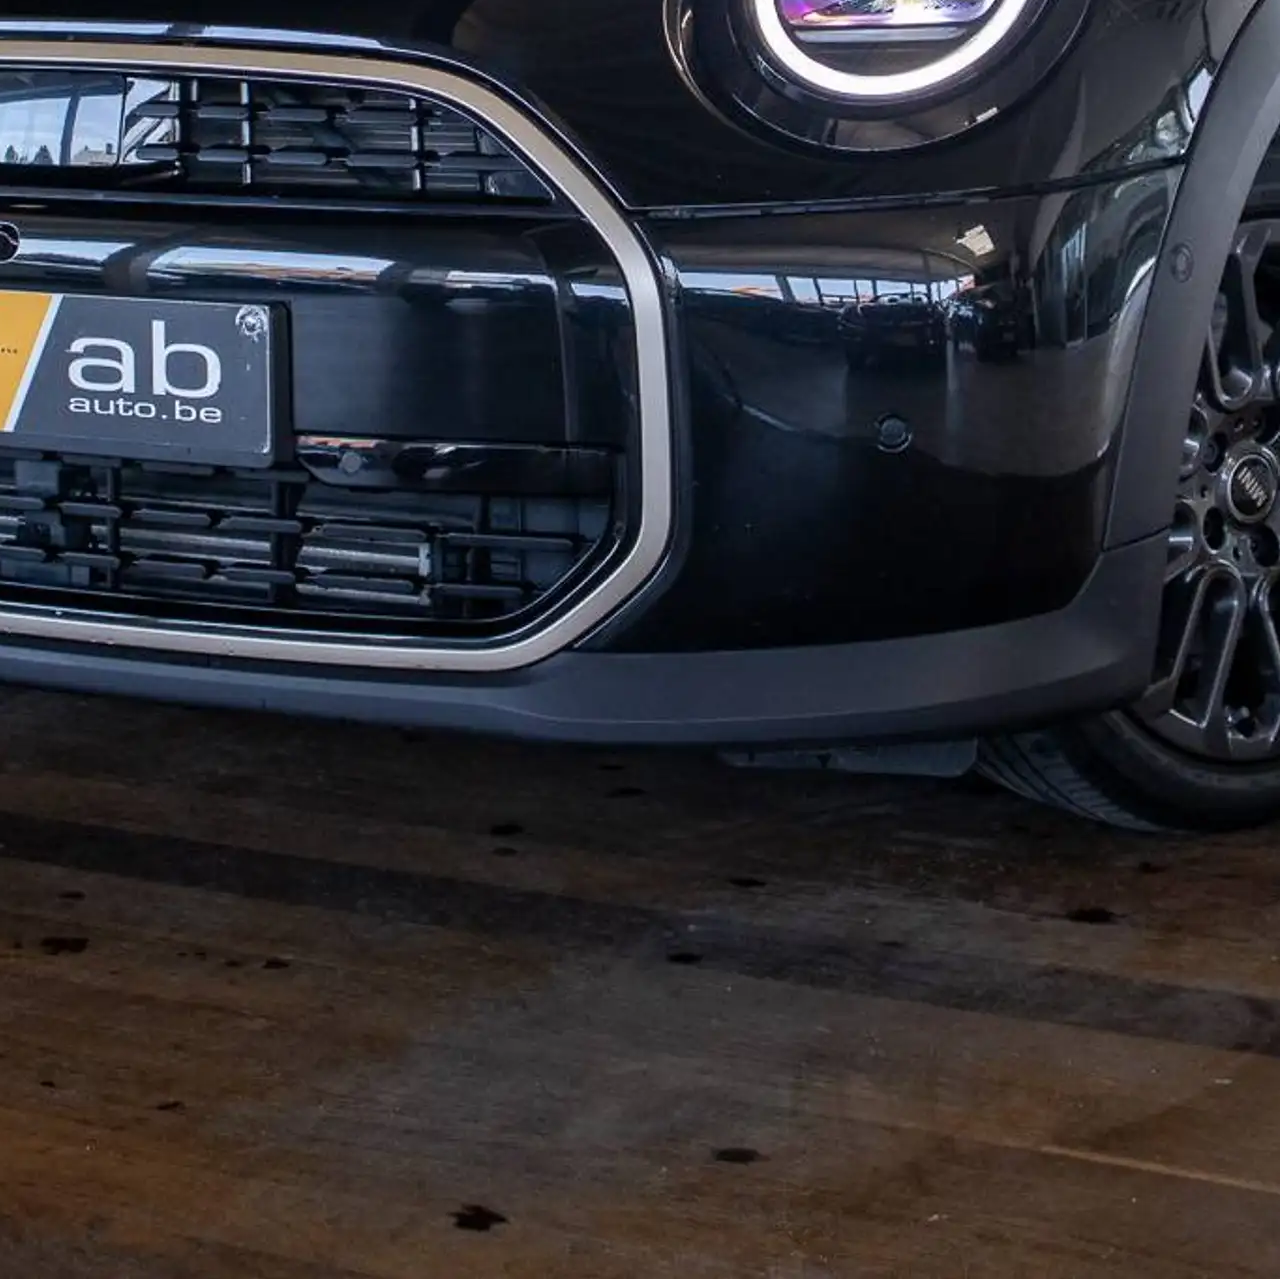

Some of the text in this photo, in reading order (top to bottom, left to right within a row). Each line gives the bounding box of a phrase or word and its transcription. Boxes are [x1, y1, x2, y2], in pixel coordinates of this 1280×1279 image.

[68, 319, 222, 399] ab
[69, 397, 223, 424] auto.be
[1237, 466, 1268, 508] MINI
